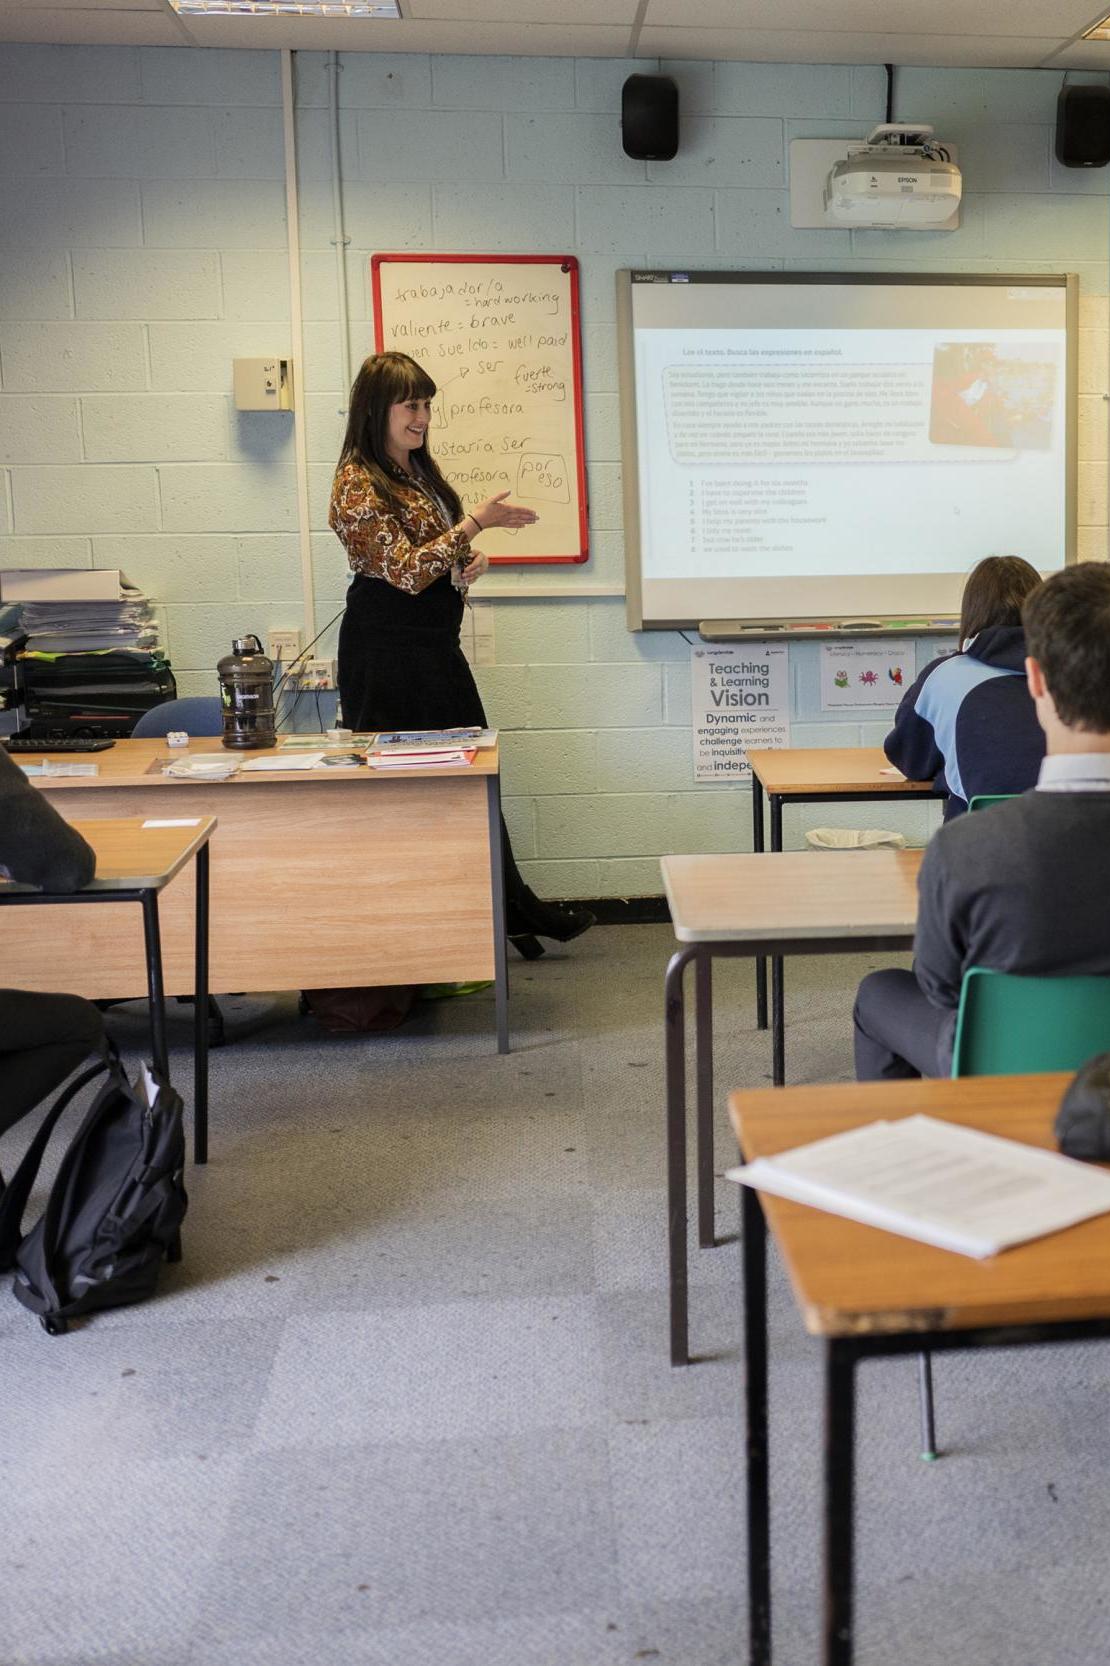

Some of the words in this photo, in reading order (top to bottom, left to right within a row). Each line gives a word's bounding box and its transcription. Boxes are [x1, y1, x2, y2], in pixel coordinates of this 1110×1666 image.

[390, 319, 450, 338] valiente
[469, 312, 516, 329] brave
[537, 333, 568, 350] paid
[514, 363, 554, 385] fuerte
[450, 396, 524, 420] profesora
[521, 459, 554, 479] por
[537, 472, 563, 488] eso
[708, 662, 770, 676] Teaching
[709, 677, 718, 687] &
[721, 676, 770, 688] Learning
[710, 689, 770, 707] Vision
[705, 712, 757, 726] Dynamic
[697, 726, 739, 736] engaging
[699, 737, 743, 747] challenge
[699, 749, 710, 757] be
[696, 763, 713, 771] and
